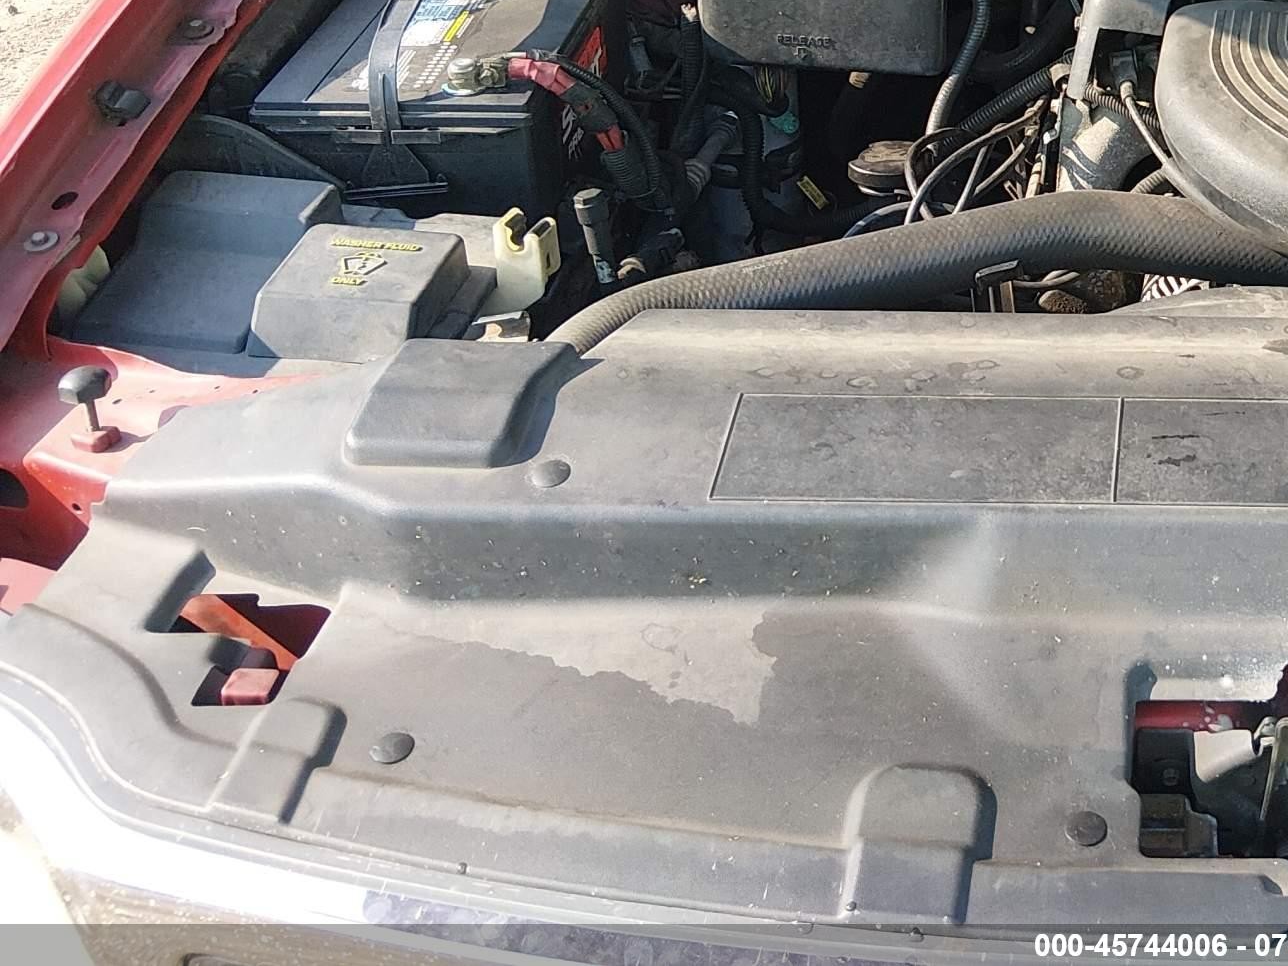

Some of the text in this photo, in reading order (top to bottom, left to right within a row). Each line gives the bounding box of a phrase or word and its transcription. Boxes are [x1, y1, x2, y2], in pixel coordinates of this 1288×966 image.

[776, 33, 832, 46] RELEASE
[331, 237, 423, 252] WASHER FLUID
[331, 276, 367, 286] ONLY
